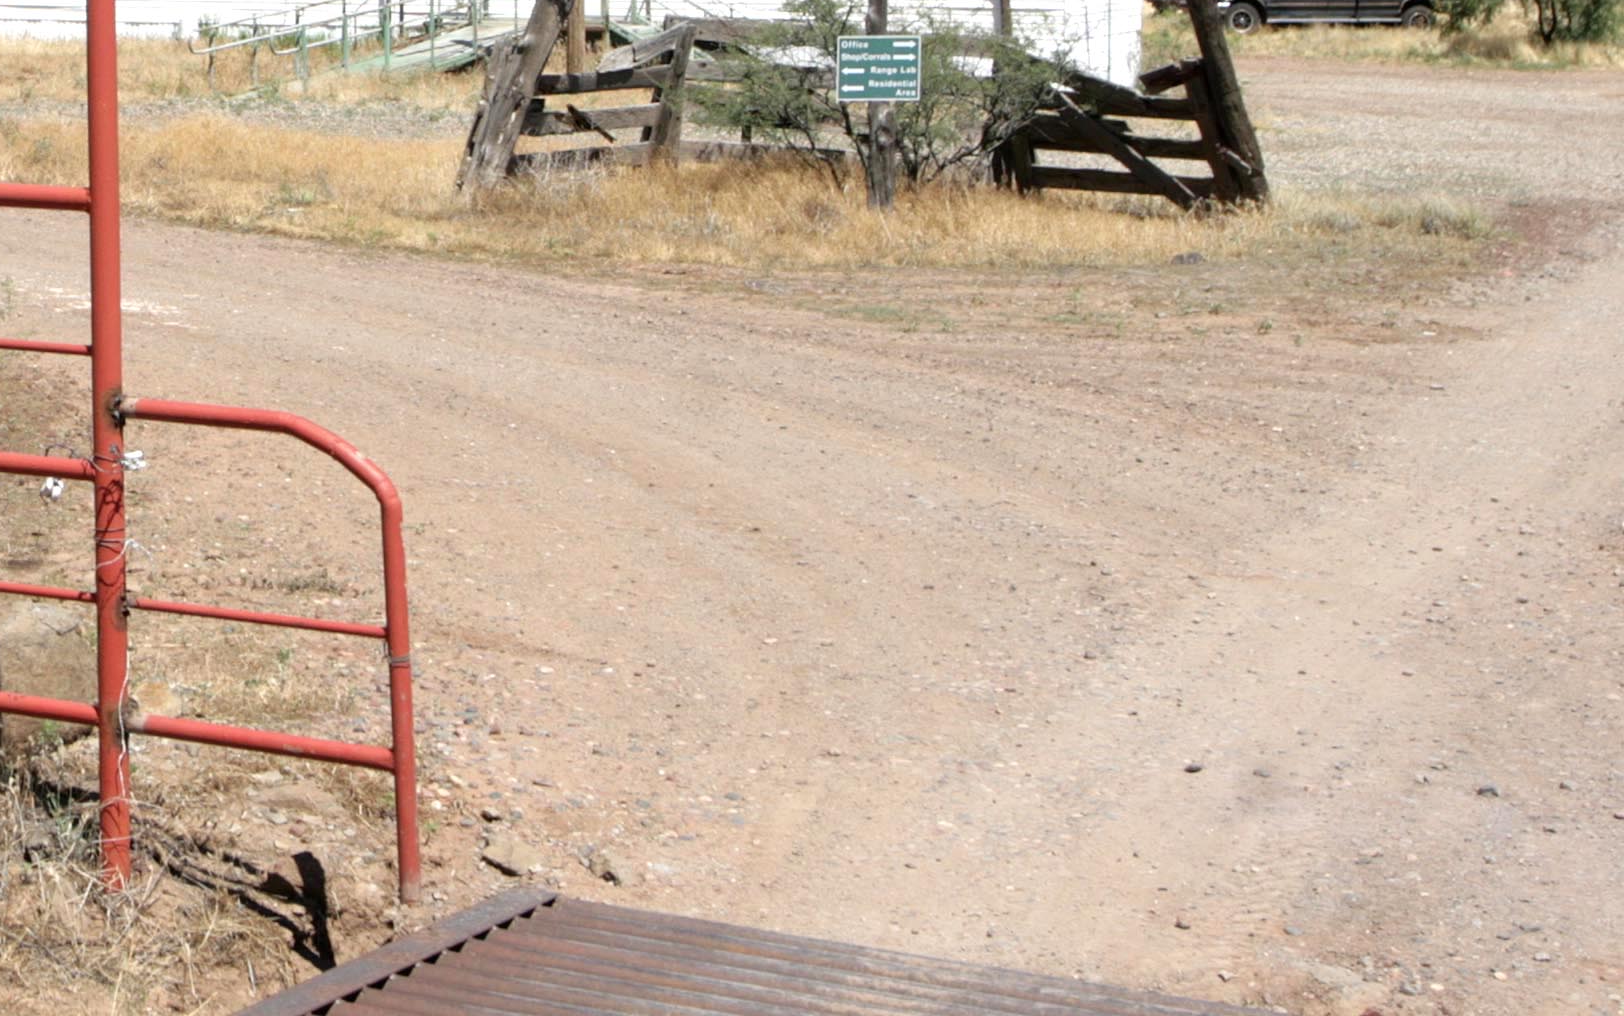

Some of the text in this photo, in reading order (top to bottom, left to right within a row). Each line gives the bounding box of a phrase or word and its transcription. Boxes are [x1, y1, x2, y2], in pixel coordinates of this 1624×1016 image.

[841, 40, 869, 49] Office
[870, 65, 917, 76] Range Lab
[868, 79, 916, 88] Residential
[895, 89, 916, 97] Area
